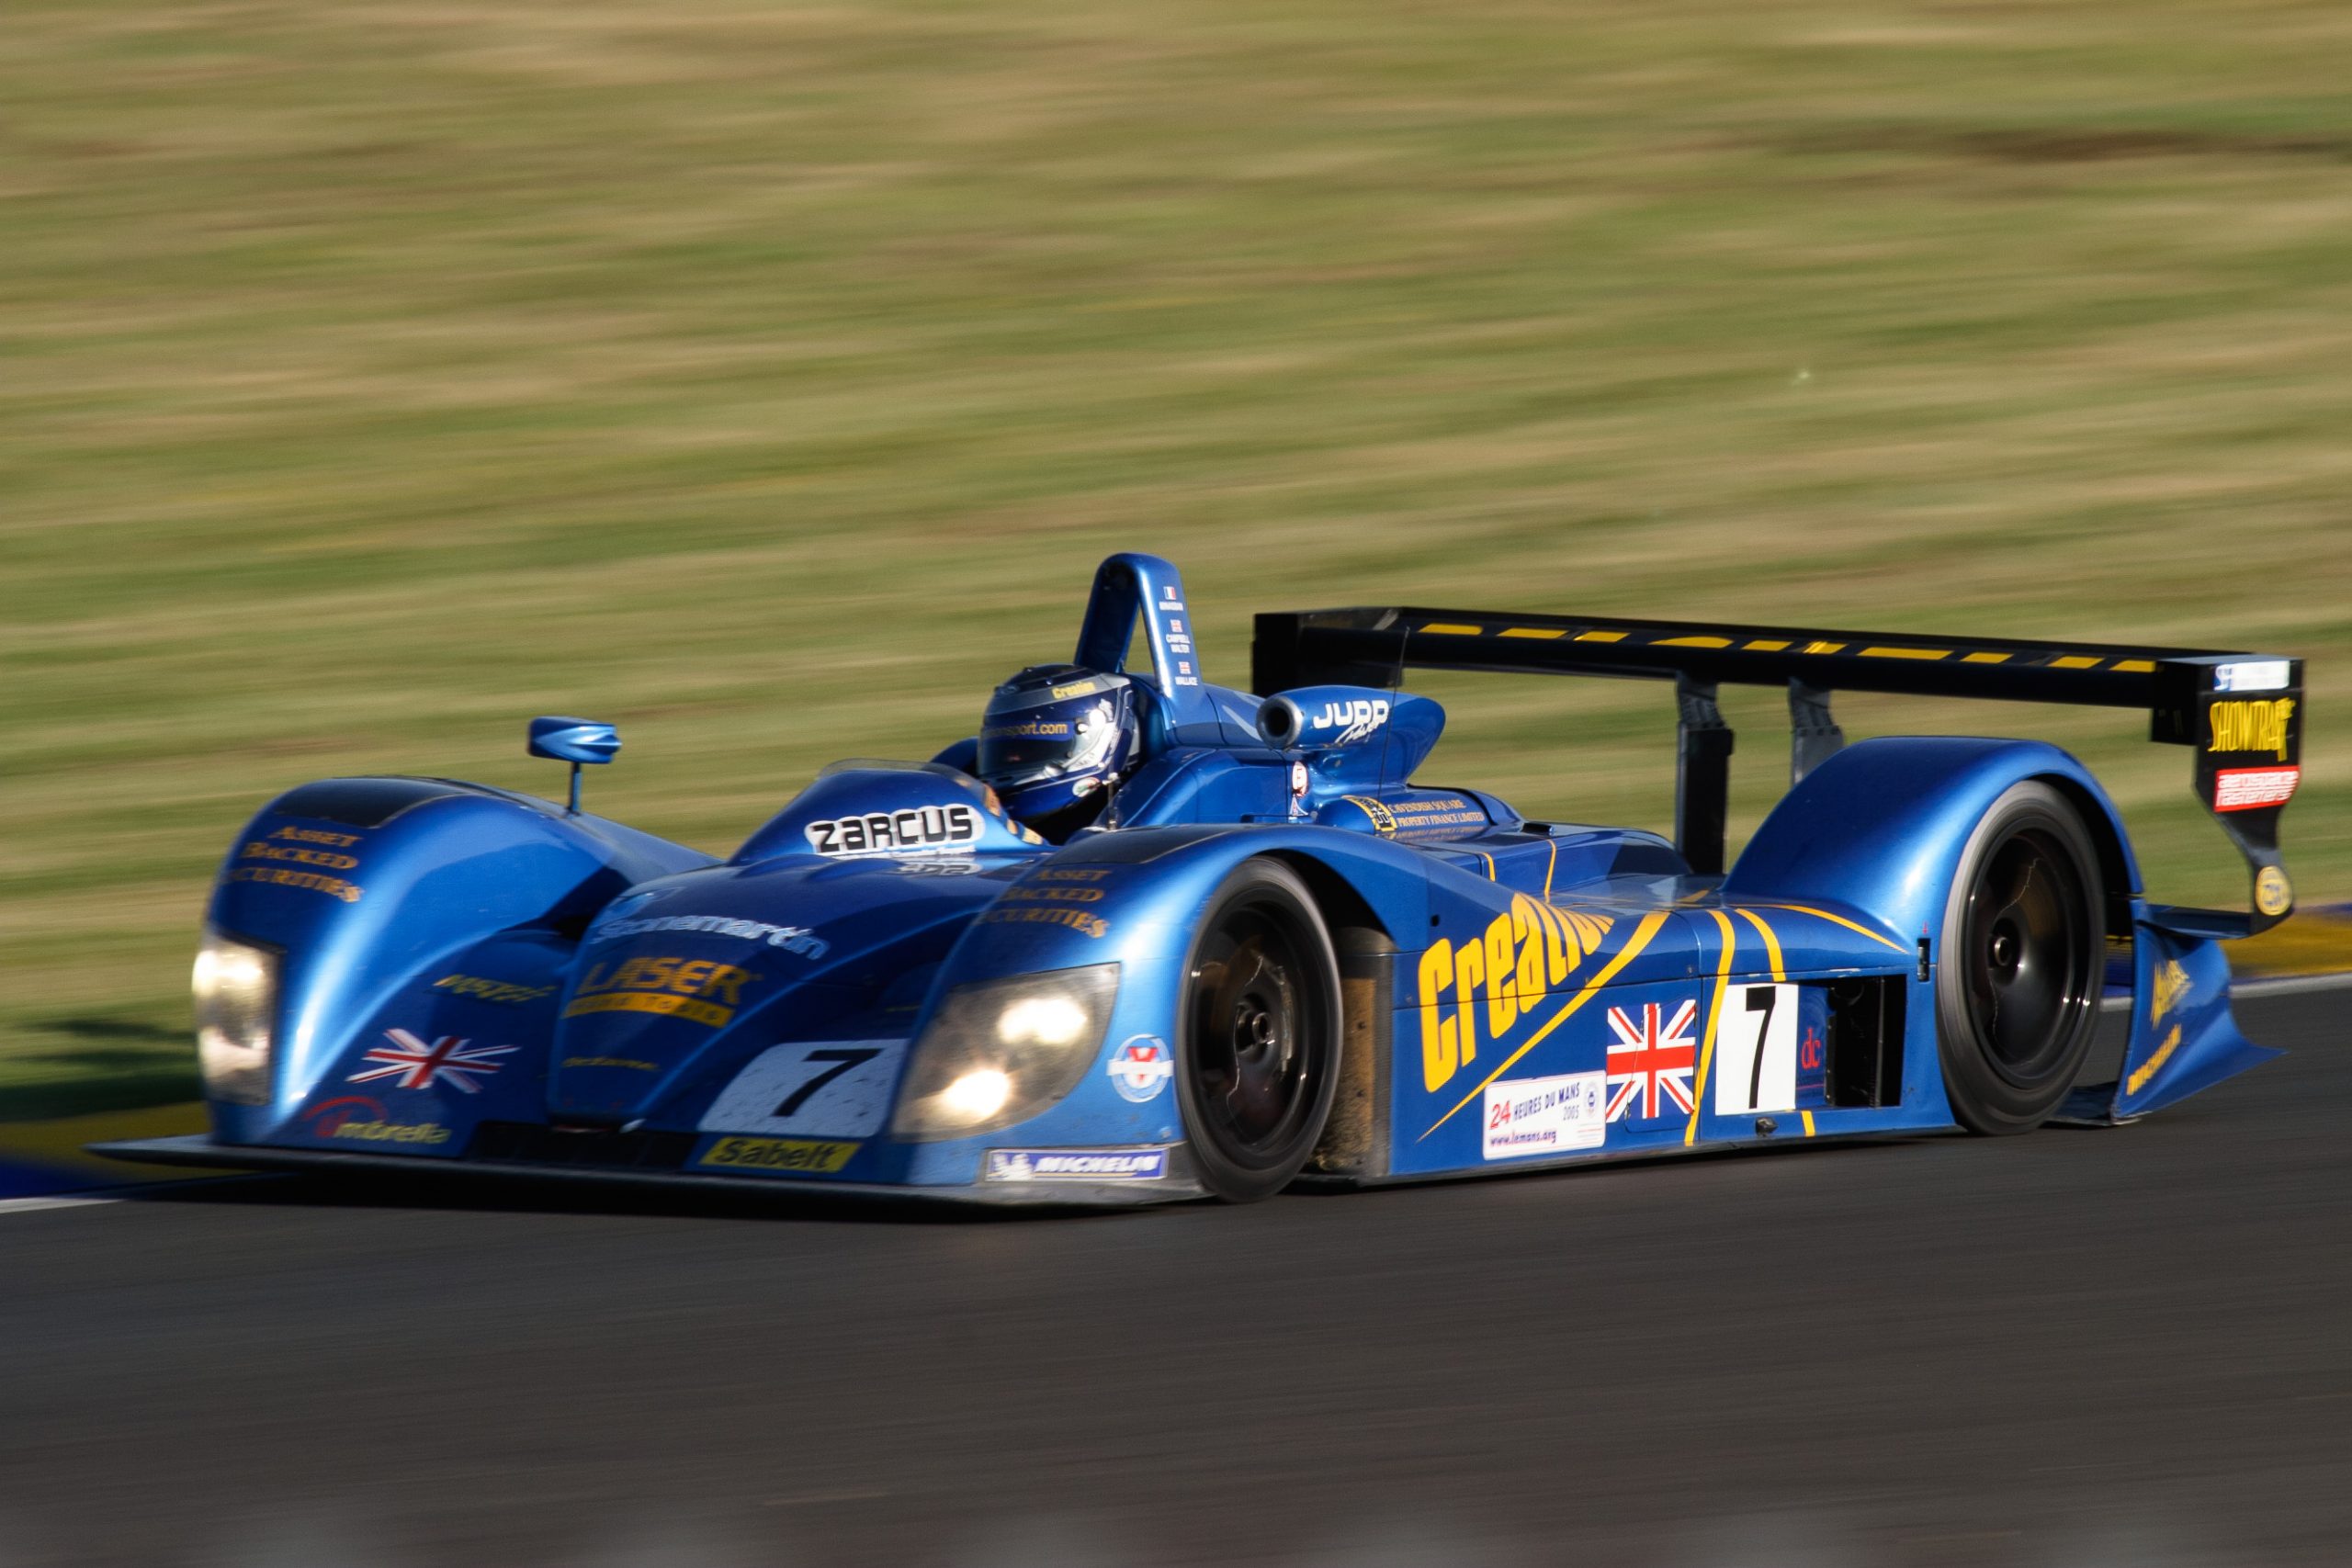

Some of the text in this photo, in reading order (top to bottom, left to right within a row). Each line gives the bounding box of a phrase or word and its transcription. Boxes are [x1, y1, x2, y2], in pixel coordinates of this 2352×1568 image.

[1313, 700, 1389, 728] JUDD
[576, 956, 751, 1005] LASER
[1418, 892, 1615, 1093] Creation
[1746, 986, 1777, 1110] 7
[771, 1048, 887, 1117] 7
[1489, 1082, 1580, 1131] 24 HEURES DU MANS
[714, 1140, 841, 1169] Sabelt
[1490, 1129, 1557, 1147] www.lemans.org
[1035, 1155, 1162, 1173] MICHELIN
